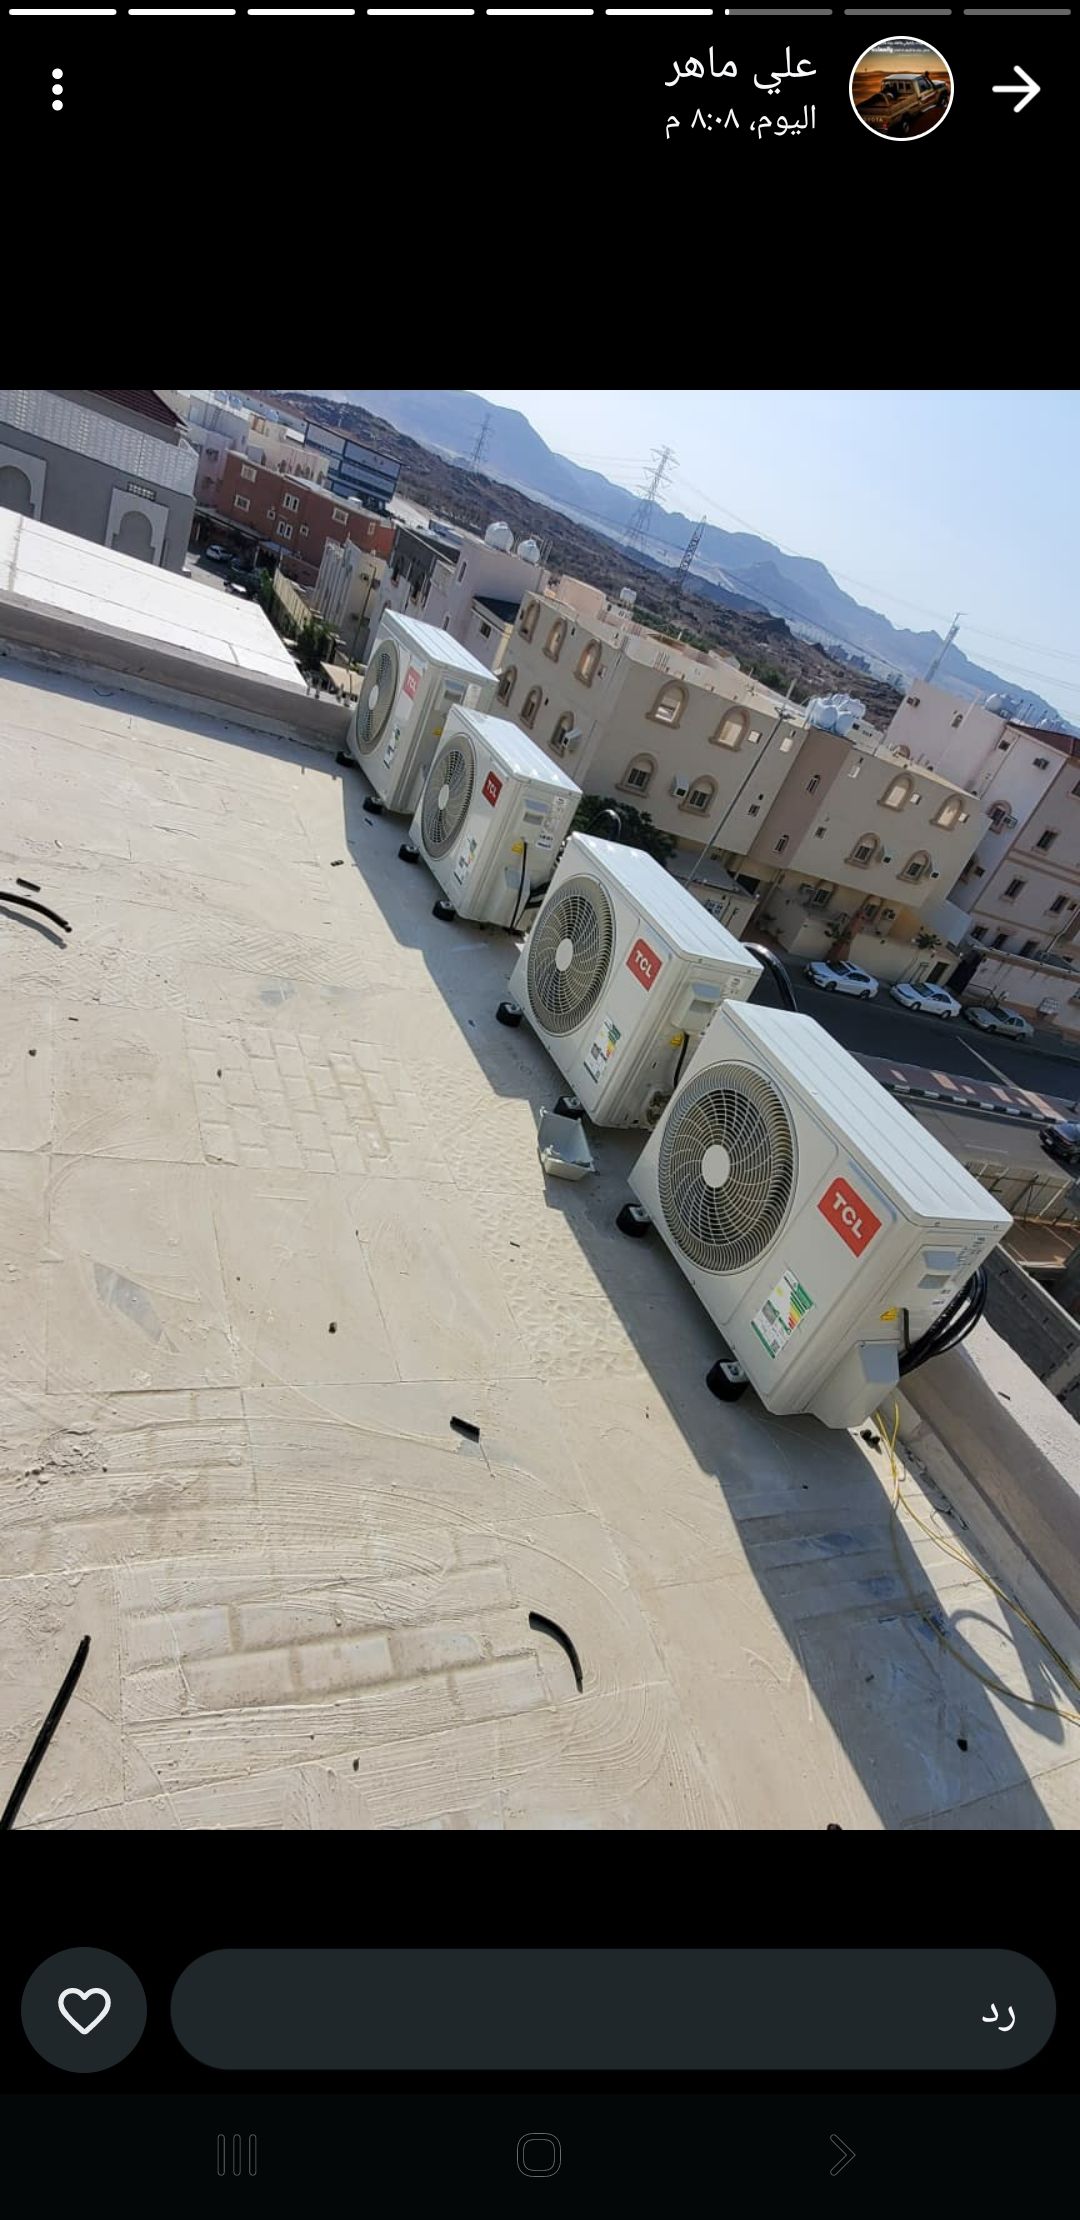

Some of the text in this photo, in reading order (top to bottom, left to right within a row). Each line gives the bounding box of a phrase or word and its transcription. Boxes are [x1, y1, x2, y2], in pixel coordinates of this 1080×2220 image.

[408, 675, 417, 691] TCL
[487, 779, 497, 798] TCL
[634, 950, 653, 978] TCL
[833, 1192, 863, 1239] TCL
